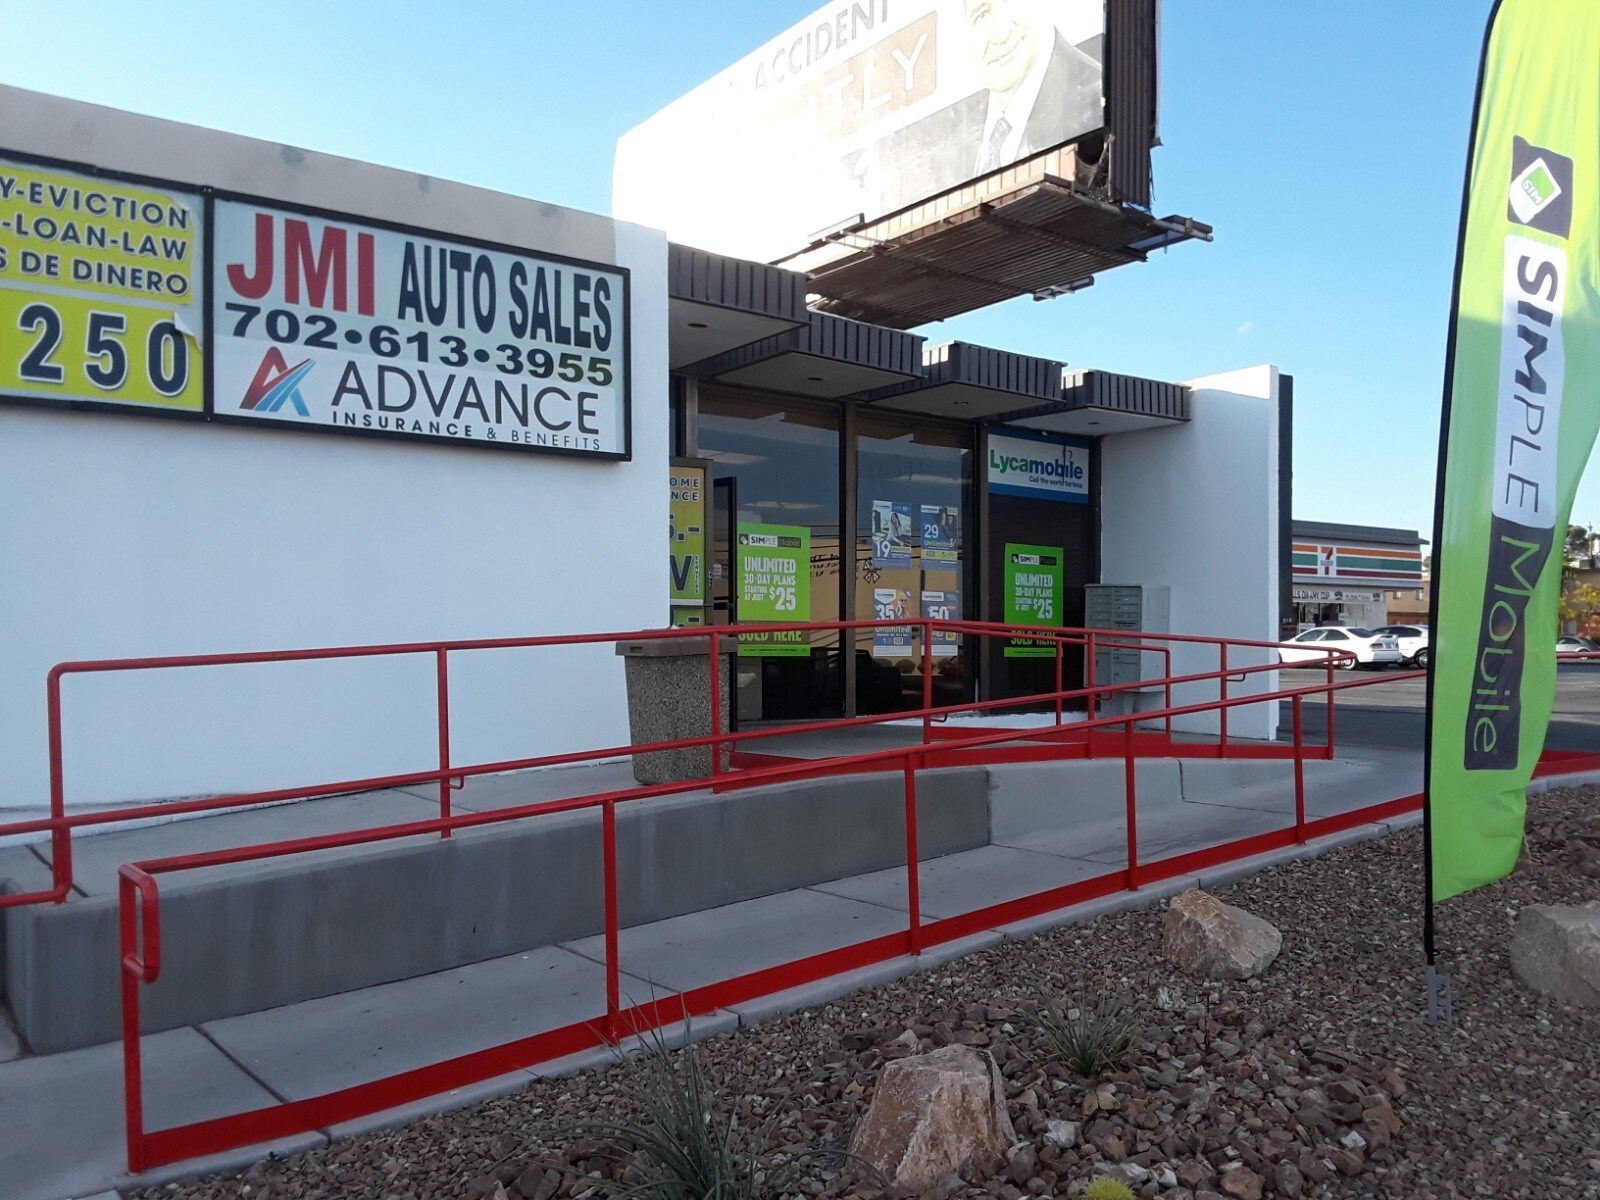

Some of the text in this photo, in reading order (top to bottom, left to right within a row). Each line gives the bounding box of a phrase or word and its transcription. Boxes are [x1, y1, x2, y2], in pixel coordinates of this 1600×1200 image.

[21, 250, 59, 276] DE
[73, 259, 188, 295] DINERO
[226, 213, 612, 352] JMI AUTO SALES
[19, 303, 188, 396] 250
[331, 360, 600, 435] ADVANCE
[333, 411, 601, 451] INSURANCE & BENEFITS
[990, 449, 1083, 480] Lycamobile
[1029, 475, 1039, 483] Call
[1040, 477, 1049, 485] the
[1474, 255, 1559, 752] SIMPLE Mobile
[751, 536, 777, 546] SIMPLE
[744, 556, 796, 574] UNLIMITED
[773, 575, 796, 586] PLANS
[1015, 572, 1054, 588] UNLIMITED
[769, 586, 797, 611] $25
[1036, 588, 1053, 598] PLANS
[1033, 599, 1054, 619] $25
